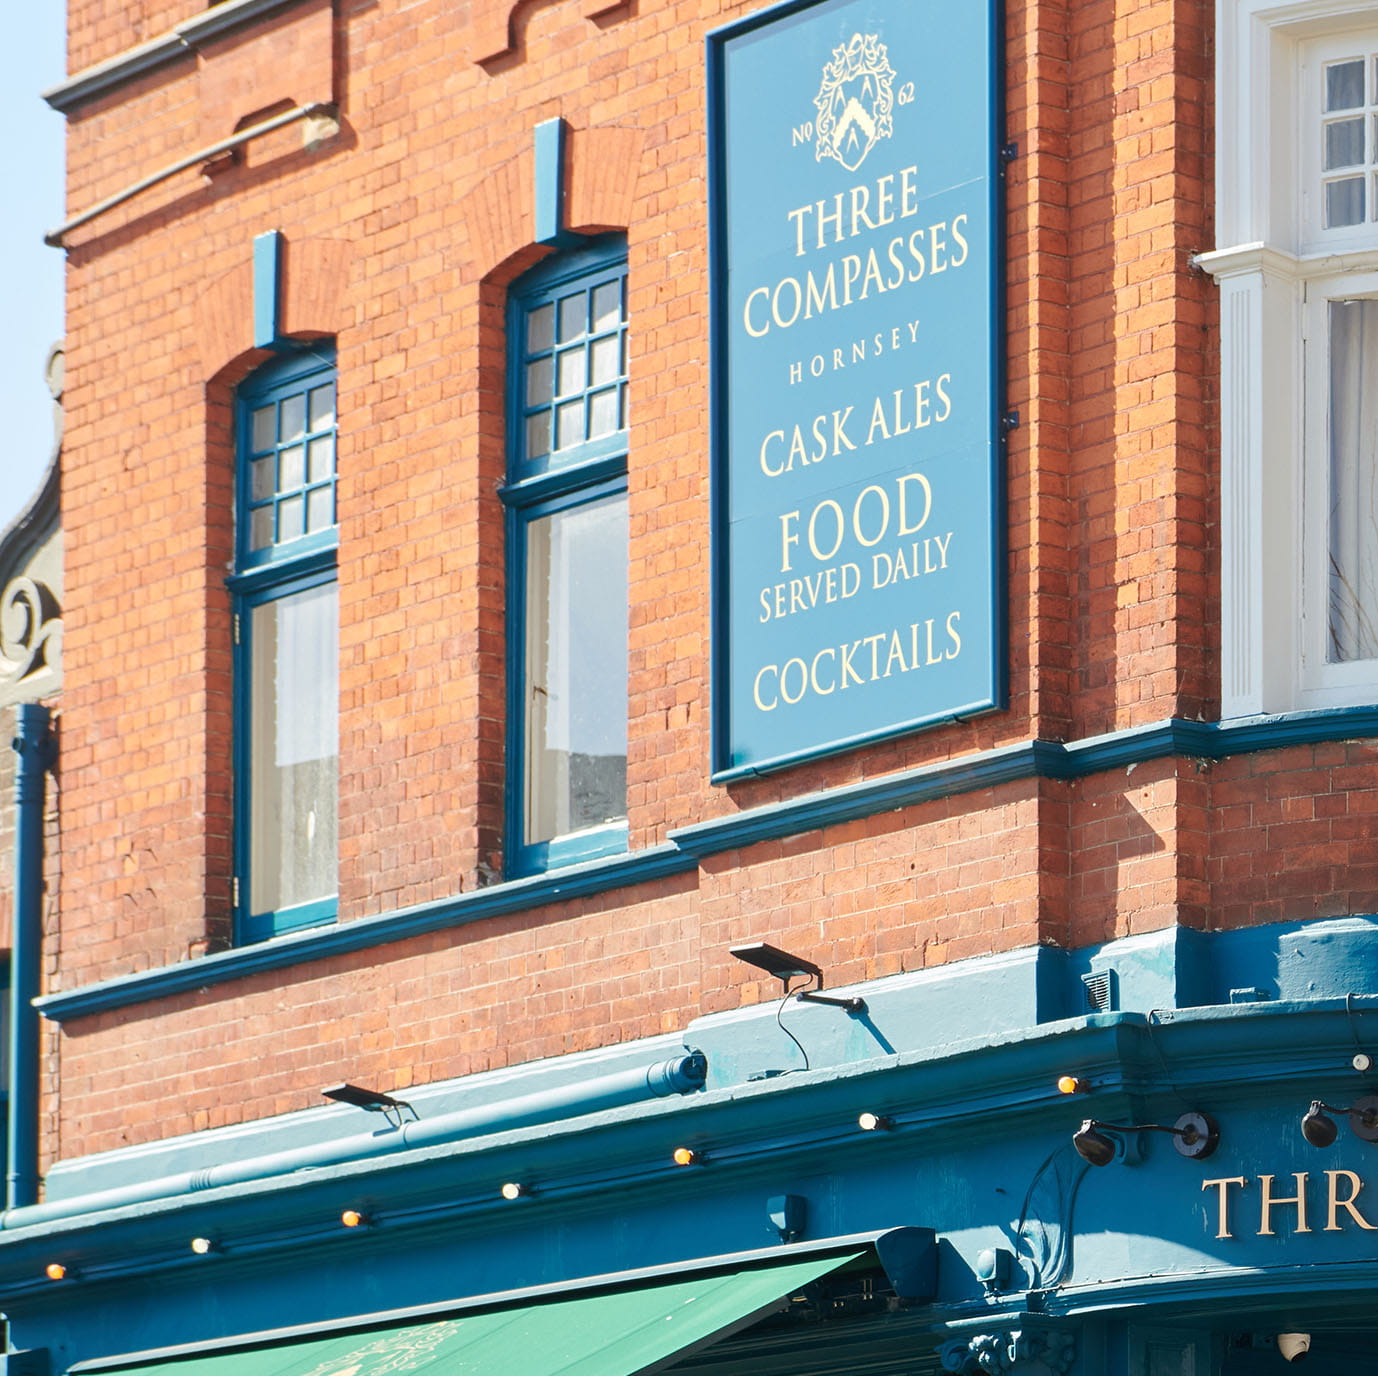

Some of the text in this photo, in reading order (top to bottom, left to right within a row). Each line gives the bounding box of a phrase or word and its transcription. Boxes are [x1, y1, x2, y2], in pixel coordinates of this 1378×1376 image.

[897, 82, 916, 106] 62
[787, 163, 920, 257] THREE
[743, 213, 970, 338] COMPASSES
[788, 319, 921, 386] HORNSEY
[760, 373, 953, 479] CASK ALES
[780, 470, 933, 573] FOOD
[759, 531, 954, 624] SERVED DAILY
[753, 610, 963, 713] COCKTAILS
